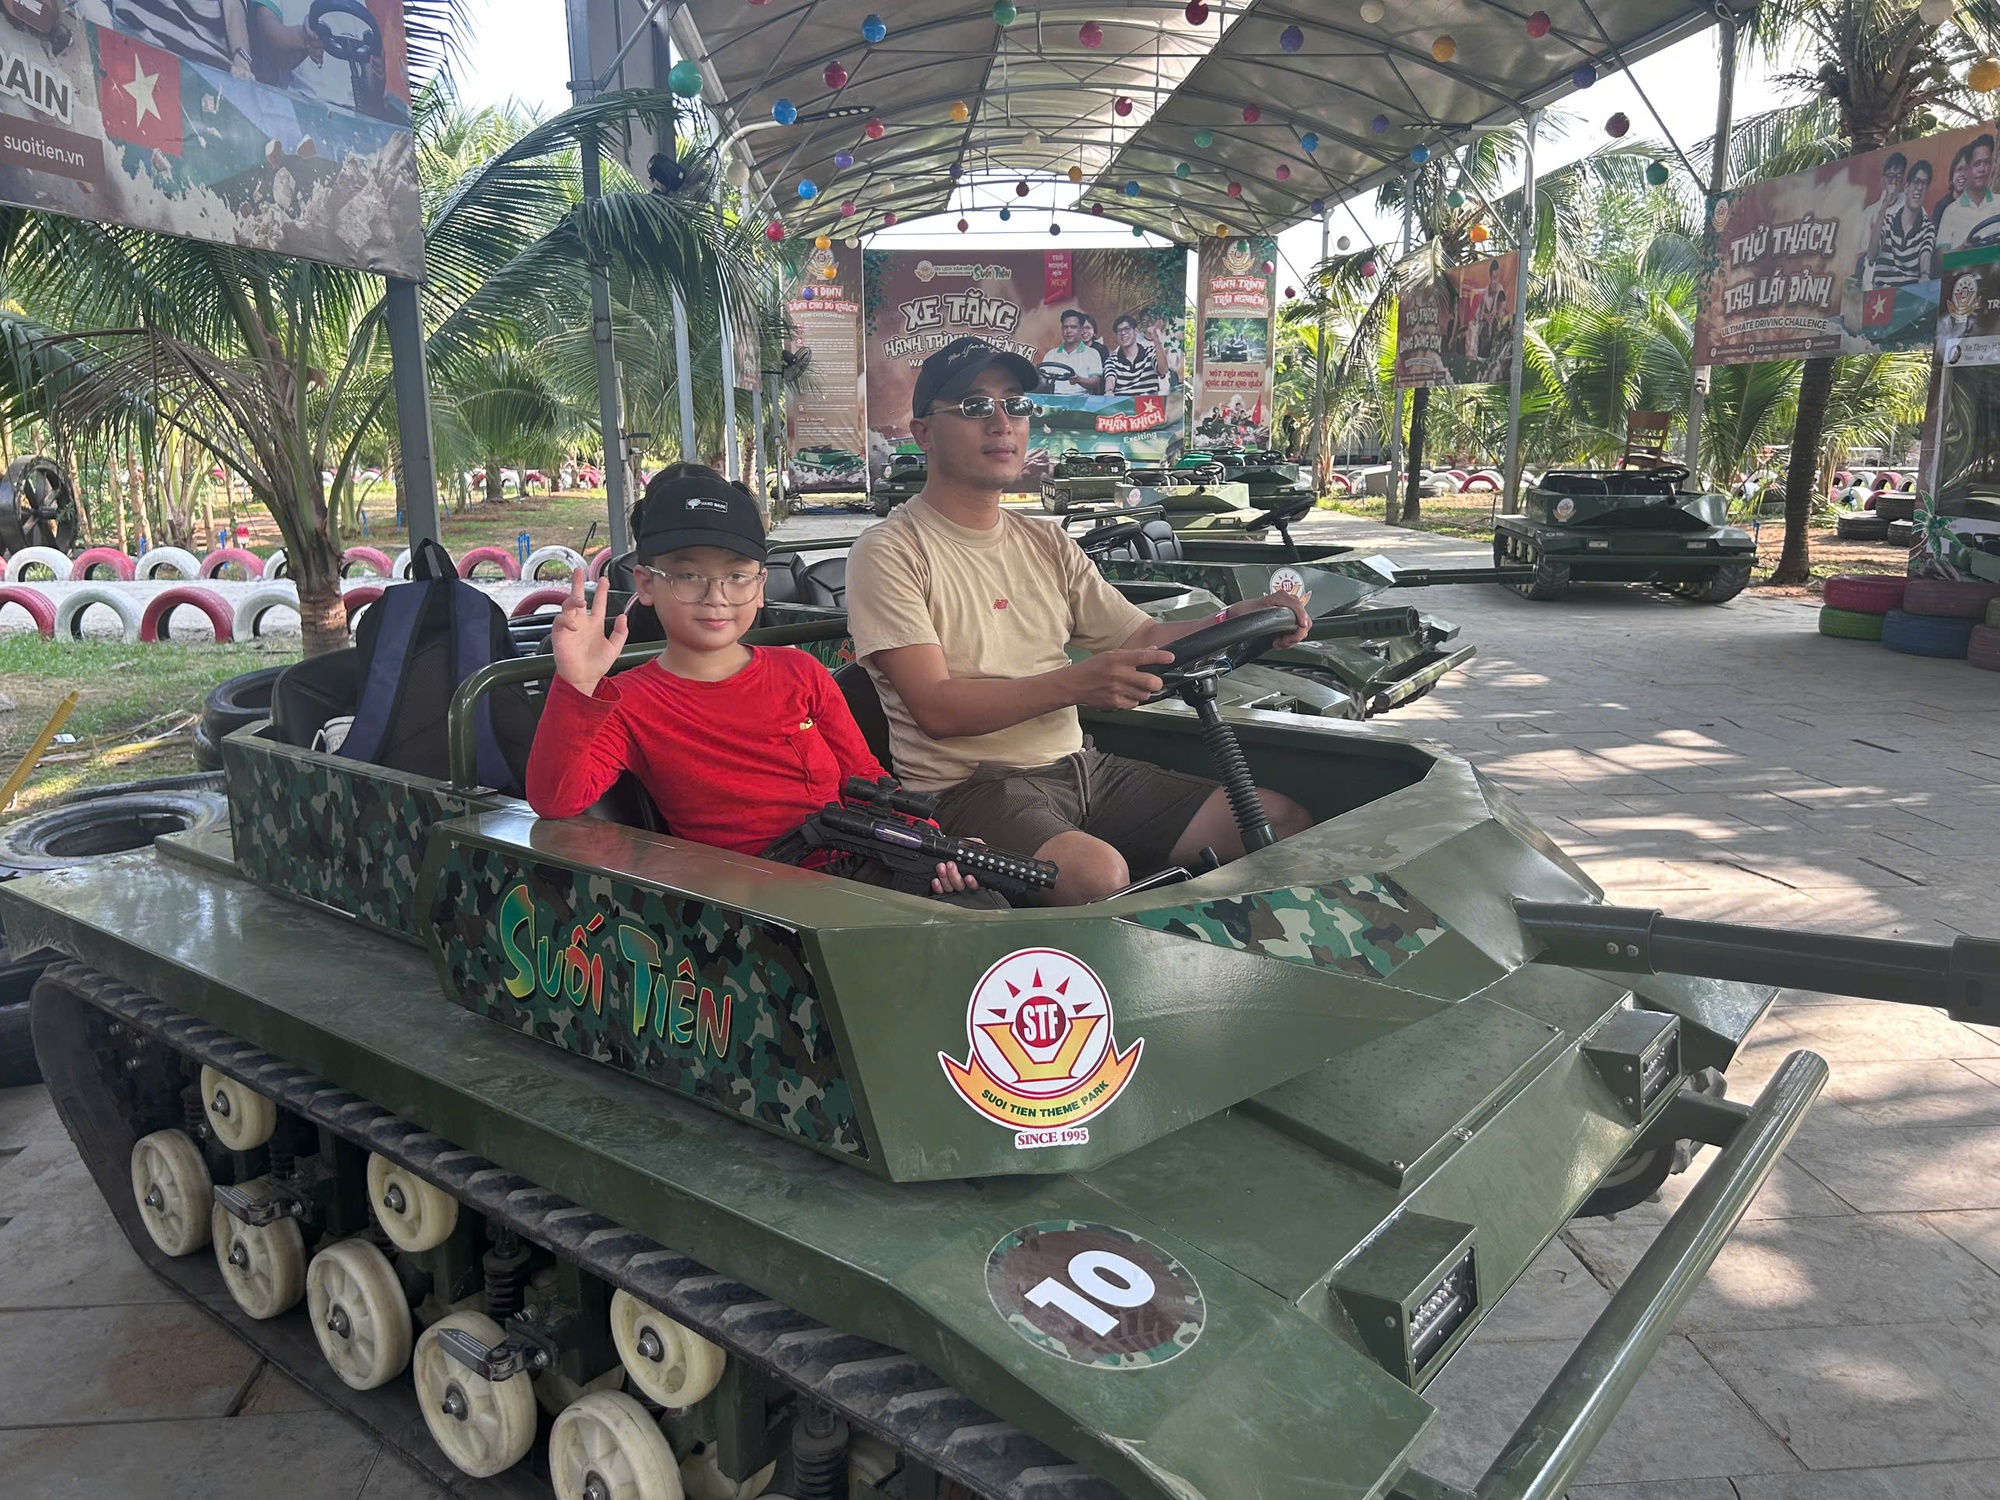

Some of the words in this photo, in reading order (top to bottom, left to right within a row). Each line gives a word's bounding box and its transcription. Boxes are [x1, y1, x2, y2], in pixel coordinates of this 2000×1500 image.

[0, 58, 68, 118] AIN
[4, 135, 85, 167] suoitien.vn
[1730, 225, 1769, 266] THỬ
[1772, 215, 1837, 255] THÁCH
[1211, 278, 1236, 290] HÀNH
[1237, 278, 1266, 291] TRÌNH
[1724, 282, 1754, 314] TAY
[1757, 269, 1785, 305] LÁI
[1788, 268, 1832, 308] ĐỈNH
[808, 302, 823, 310] CHO
[835, 301, 859, 313] KHÁCH
[901, 298, 942, 330] XE
[945, 289, 1018, 330] TĂNG
[1721, 320, 1754, 337] ULTIMATE
[1755, 318, 1784, 331] DRIVING
[1784, 317, 1828, 331] CHALLENGE
[884, 335, 924, 357] HÀNH
[1098, 413, 1128, 432] PHẤN
[1129, 409, 1165, 430] KHÍCH
[1123, 431, 1158, 444] Exciting
[1282, 581, 1292, 590] STF
[1022, 1003, 1059, 1042] STF
[981, 1088, 1007, 1110] SUOI
[1010, 1104, 1037, 1118] TIEN
[1039, 1100, 1080, 1118] THEME
[1081, 1079, 1110, 1106] PARK
[1017, 1130, 1058, 1146] SINCE
[1061, 1128, 1087, 1143] 1995
[1024, 1250, 1155, 1337] 10
